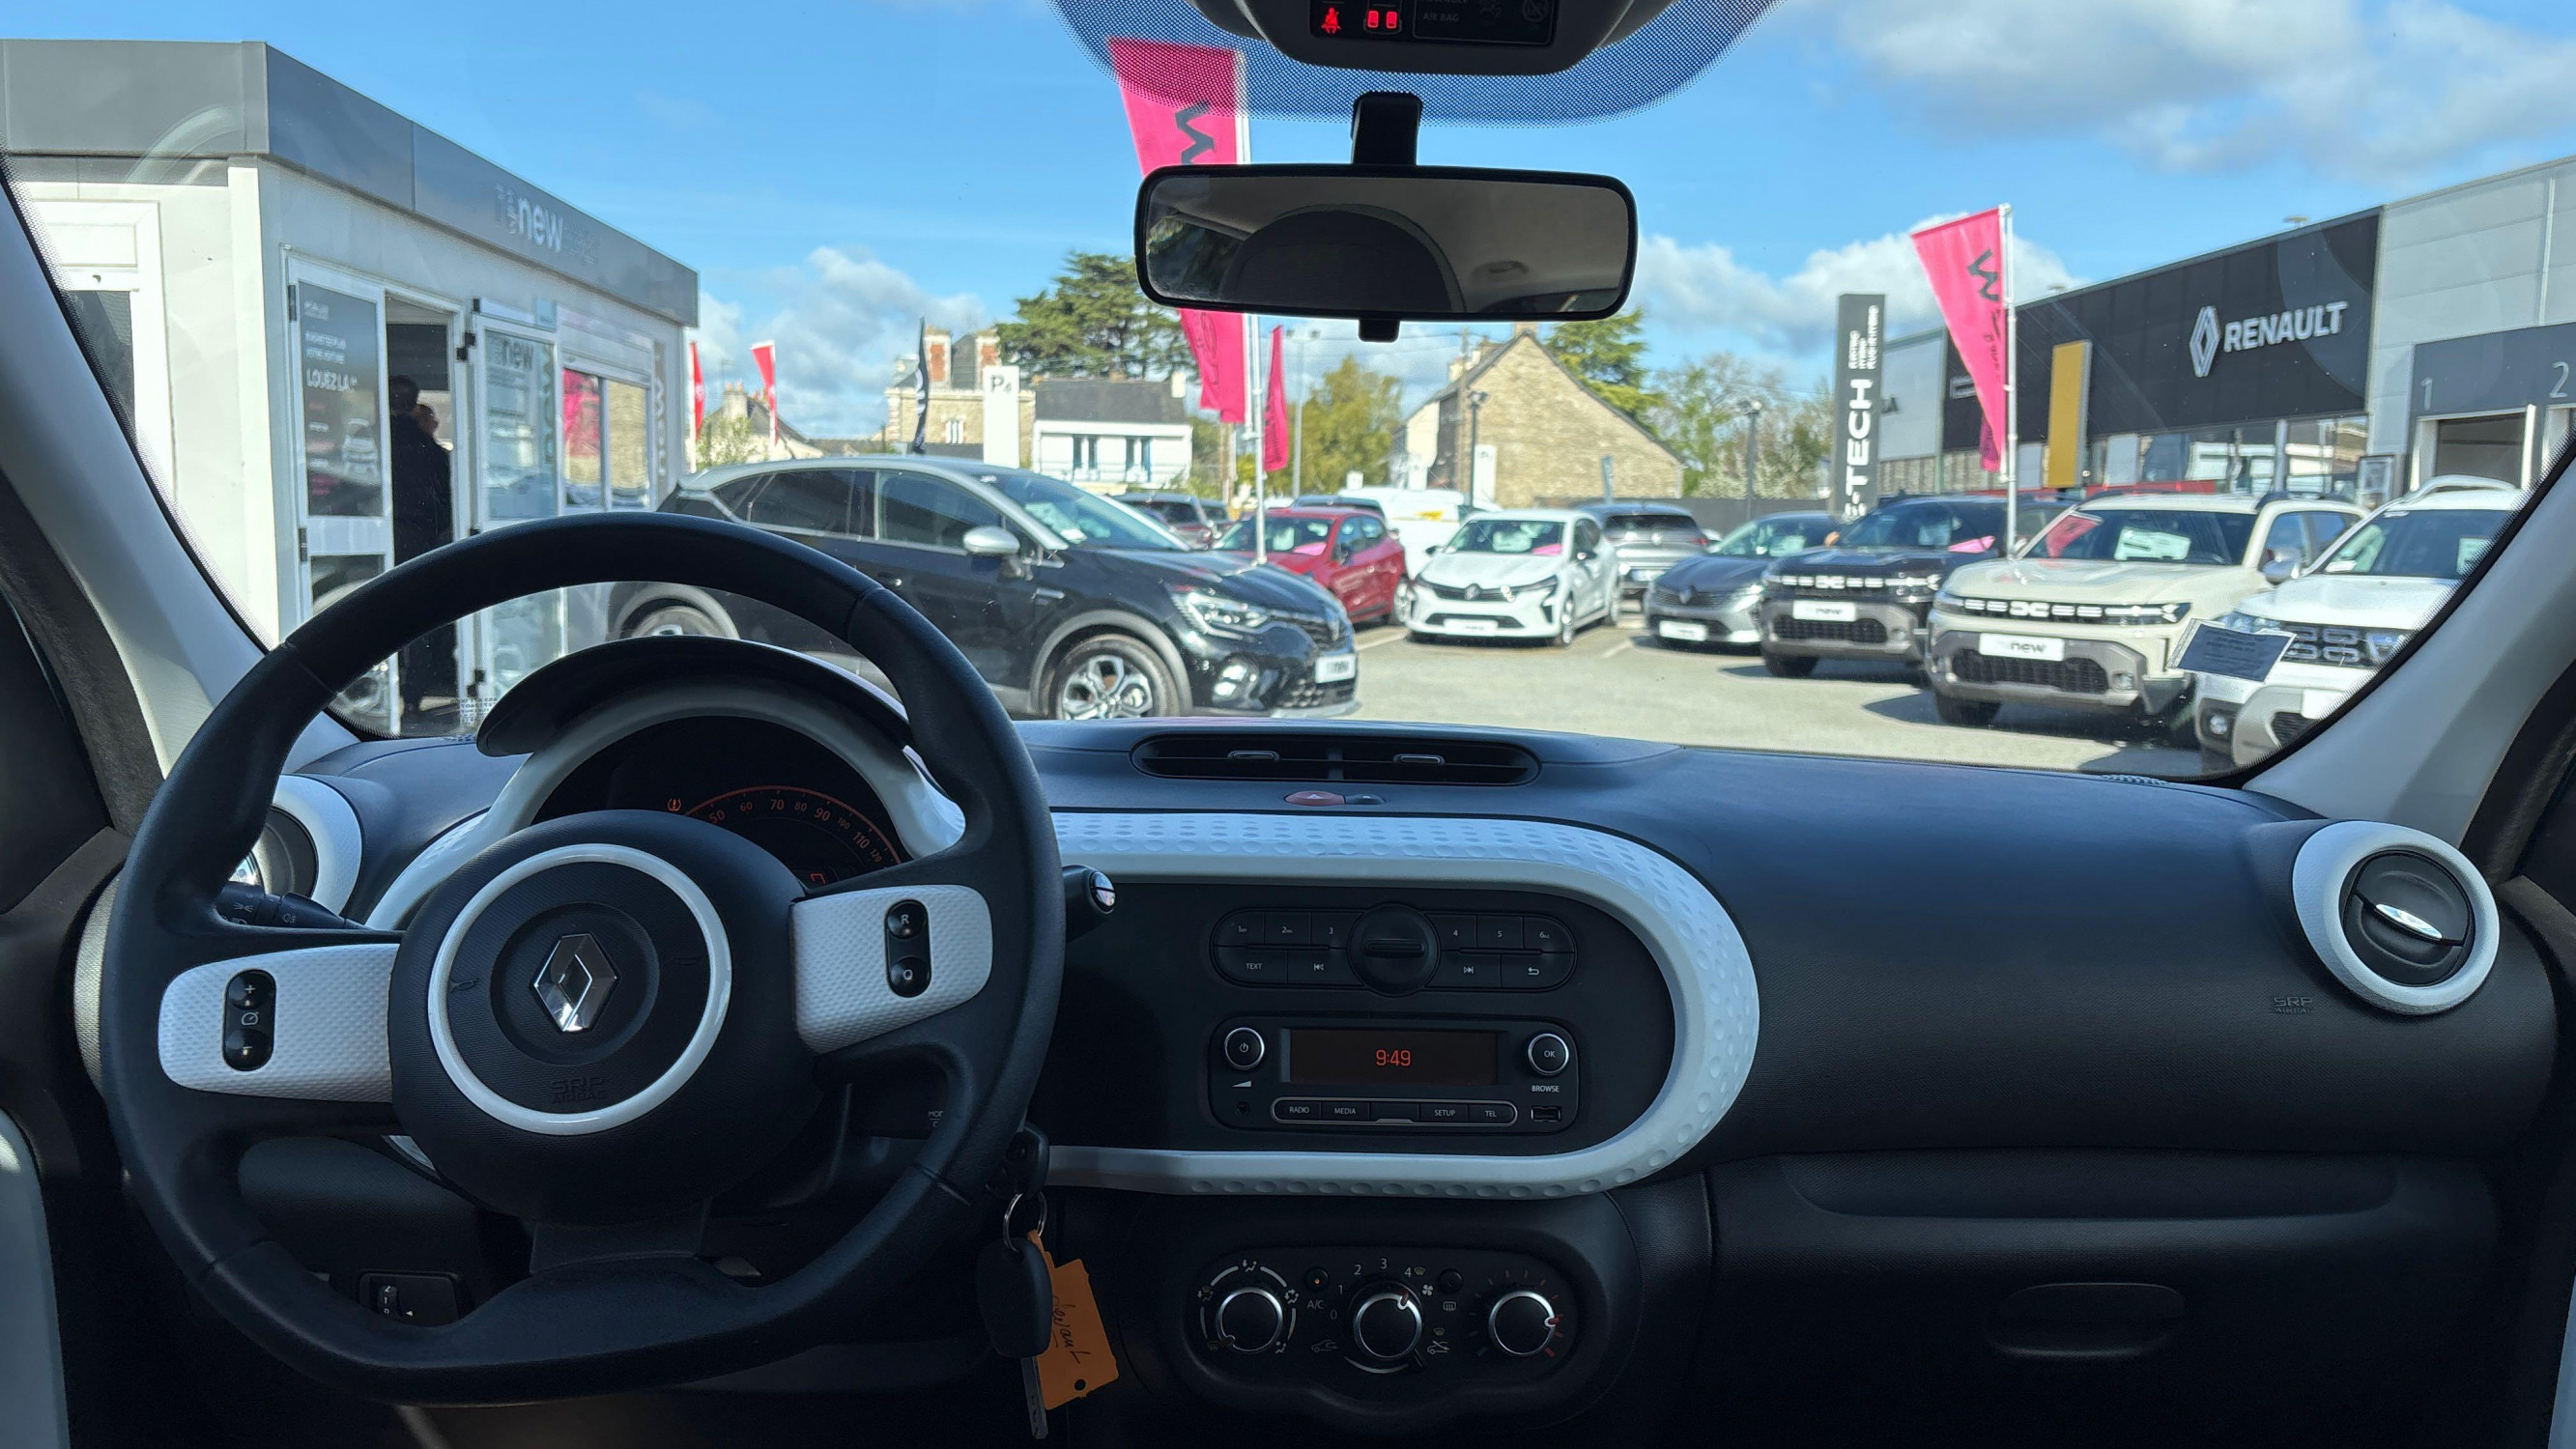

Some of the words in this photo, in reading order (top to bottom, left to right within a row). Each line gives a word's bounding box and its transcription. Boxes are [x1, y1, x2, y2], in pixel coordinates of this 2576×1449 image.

[2223, 300, 2350, 354] RENAULT
[2548, 360, 2570, 399] 2
[2420, 377, 2434, 411] 1
[1845, 379, 1873, 517] E-TECH
[739, 801, 754, 812] 60
[770, 799, 785, 811] 70
[794, 802, 808, 812] 80
[709, 810, 726, 824] 50
[815, 808, 831, 822] 90
[838, 817, 851, 831] 100
[852, 831, 871, 850] 110
[870, 849, 883, 864] 120
[901, 914, 910, 924] R
[1329, 926, 1333, 935] 3
[1245, 962, 1263, 971] TEXT
[1375, 1049, 1412, 1067] 9:49
[1543, 1050, 1556, 1059] OK
[551, 1077, 605, 1094] SRP
[1531, 1085, 1560, 1094] BROWSE
[1289, 1106, 1310, 1115] RADIO
[1333, 1107, 1357, 1116] MEDIA
[1434, 1109, 1456, 1119] SETUP
[1484, 1110, 1498, 1119] TEL
[1354, 1264, 1361, 1276] 2
[1380, 1258, 1388, 1270] 3
[1404, 1266, 1412, 1278] 4
[1338, 1284, 1344, 1295] 1
[1306, 1299, 1324, 1311] A/C
[1330, 1308, 1338, 1321] 0
